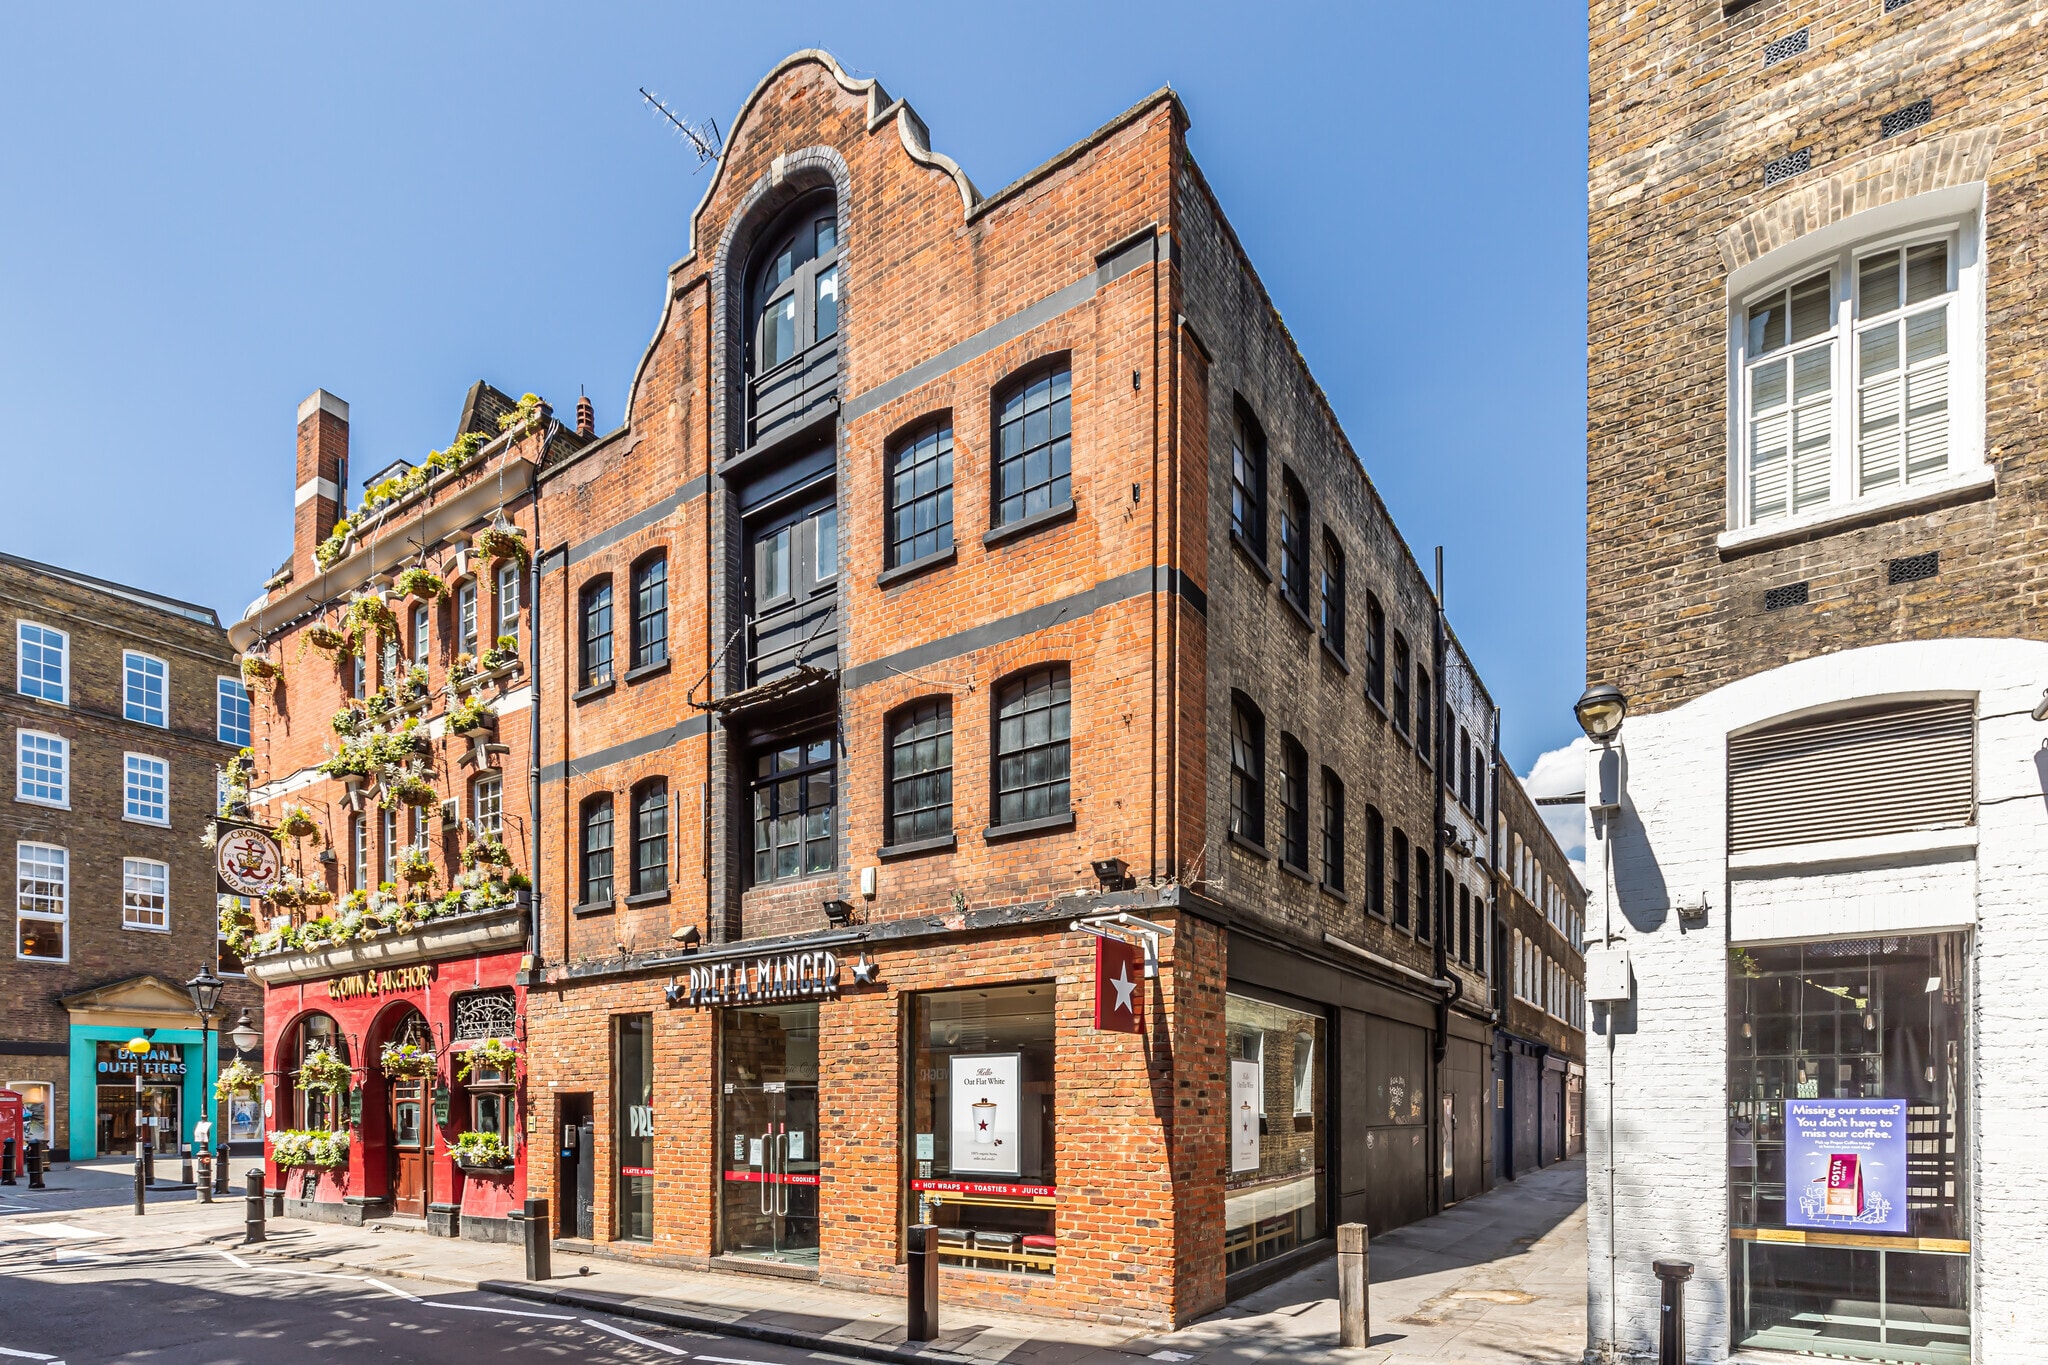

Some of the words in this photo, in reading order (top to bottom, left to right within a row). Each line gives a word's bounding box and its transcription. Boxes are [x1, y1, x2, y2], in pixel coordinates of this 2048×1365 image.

[231, 829, 269, 844] CROWN
[220, 869, 239, 887] AND
[328, 977, 365, 998] CROWN
[367, 969, 378, 993] &
[381, 965, 430, 990] ANCHOR
[690, 963, 732, 1005] PRET
[737, 961, 750, 1000] A
[757, 951, 837, 999] MANGER
[98, 1061, 188, 1074] OUTFTTERS
[976, 1068, 993, 1076] Hello
[976, 1077, 987, 1085] Flat
[988, 1077, 1005, 1085] White
[1793, 1105, 1836, 1118] Missing
[1860, 1105, 1901, 1115] stores?
[1796, 1117, 1817, 1127] You
[1820, 1117, 1848, 1127] don't
[1850, 1118, 1878, 1128] have
[1880, 1120, 1893, 1128] to
[1802, 1128, 1827, 1138] miss
[1851, 1128, 1892, 1139] coffee.
[792, 1176, 816, 1184] COOKIES
[1831, 1160, 1842, 1187] COSTA
[974, 1185, 1007, 1193] TOASTIES
